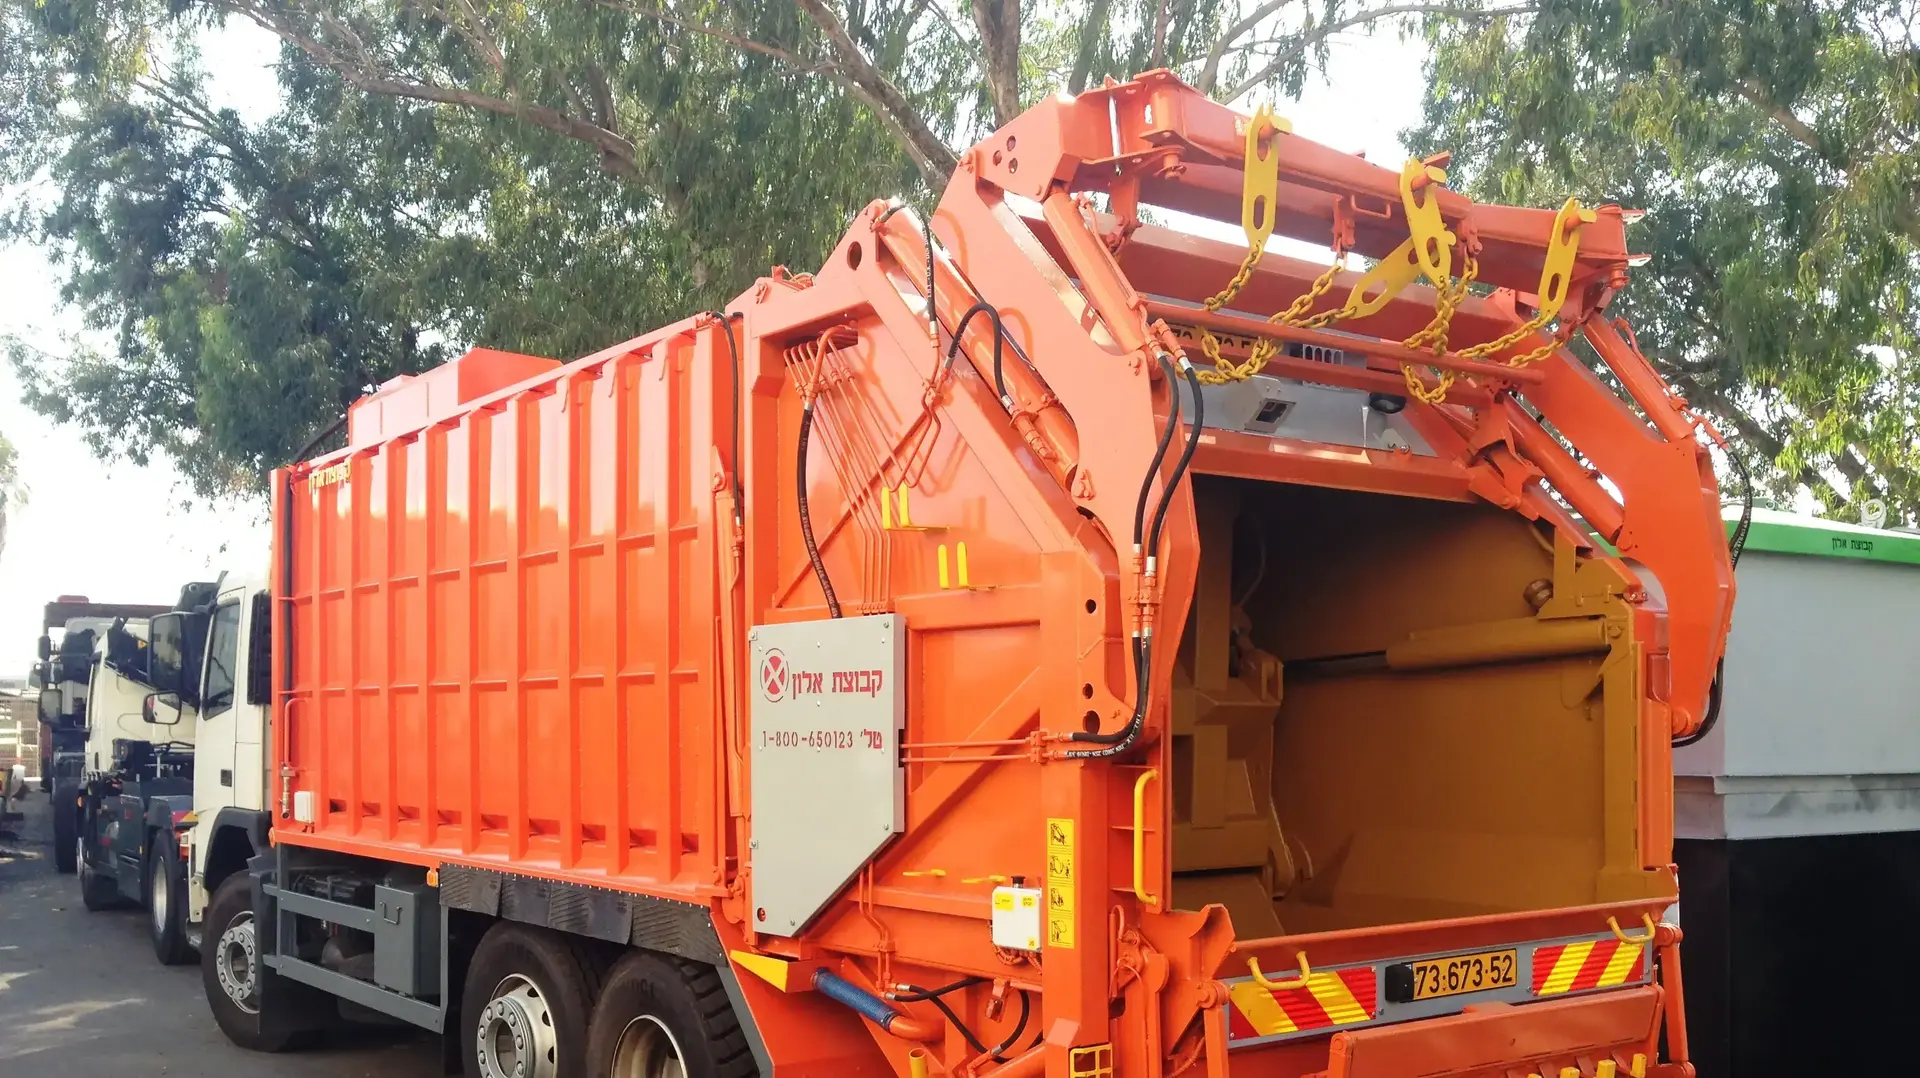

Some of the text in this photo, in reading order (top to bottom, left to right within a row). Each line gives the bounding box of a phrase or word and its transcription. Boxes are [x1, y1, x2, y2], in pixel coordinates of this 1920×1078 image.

[1831, 537, 1874, 553] קבוצת אלון
[791, 669, 883, 700] קבוצת אלון
[762, 730, 853, 748] 1-800-650123
